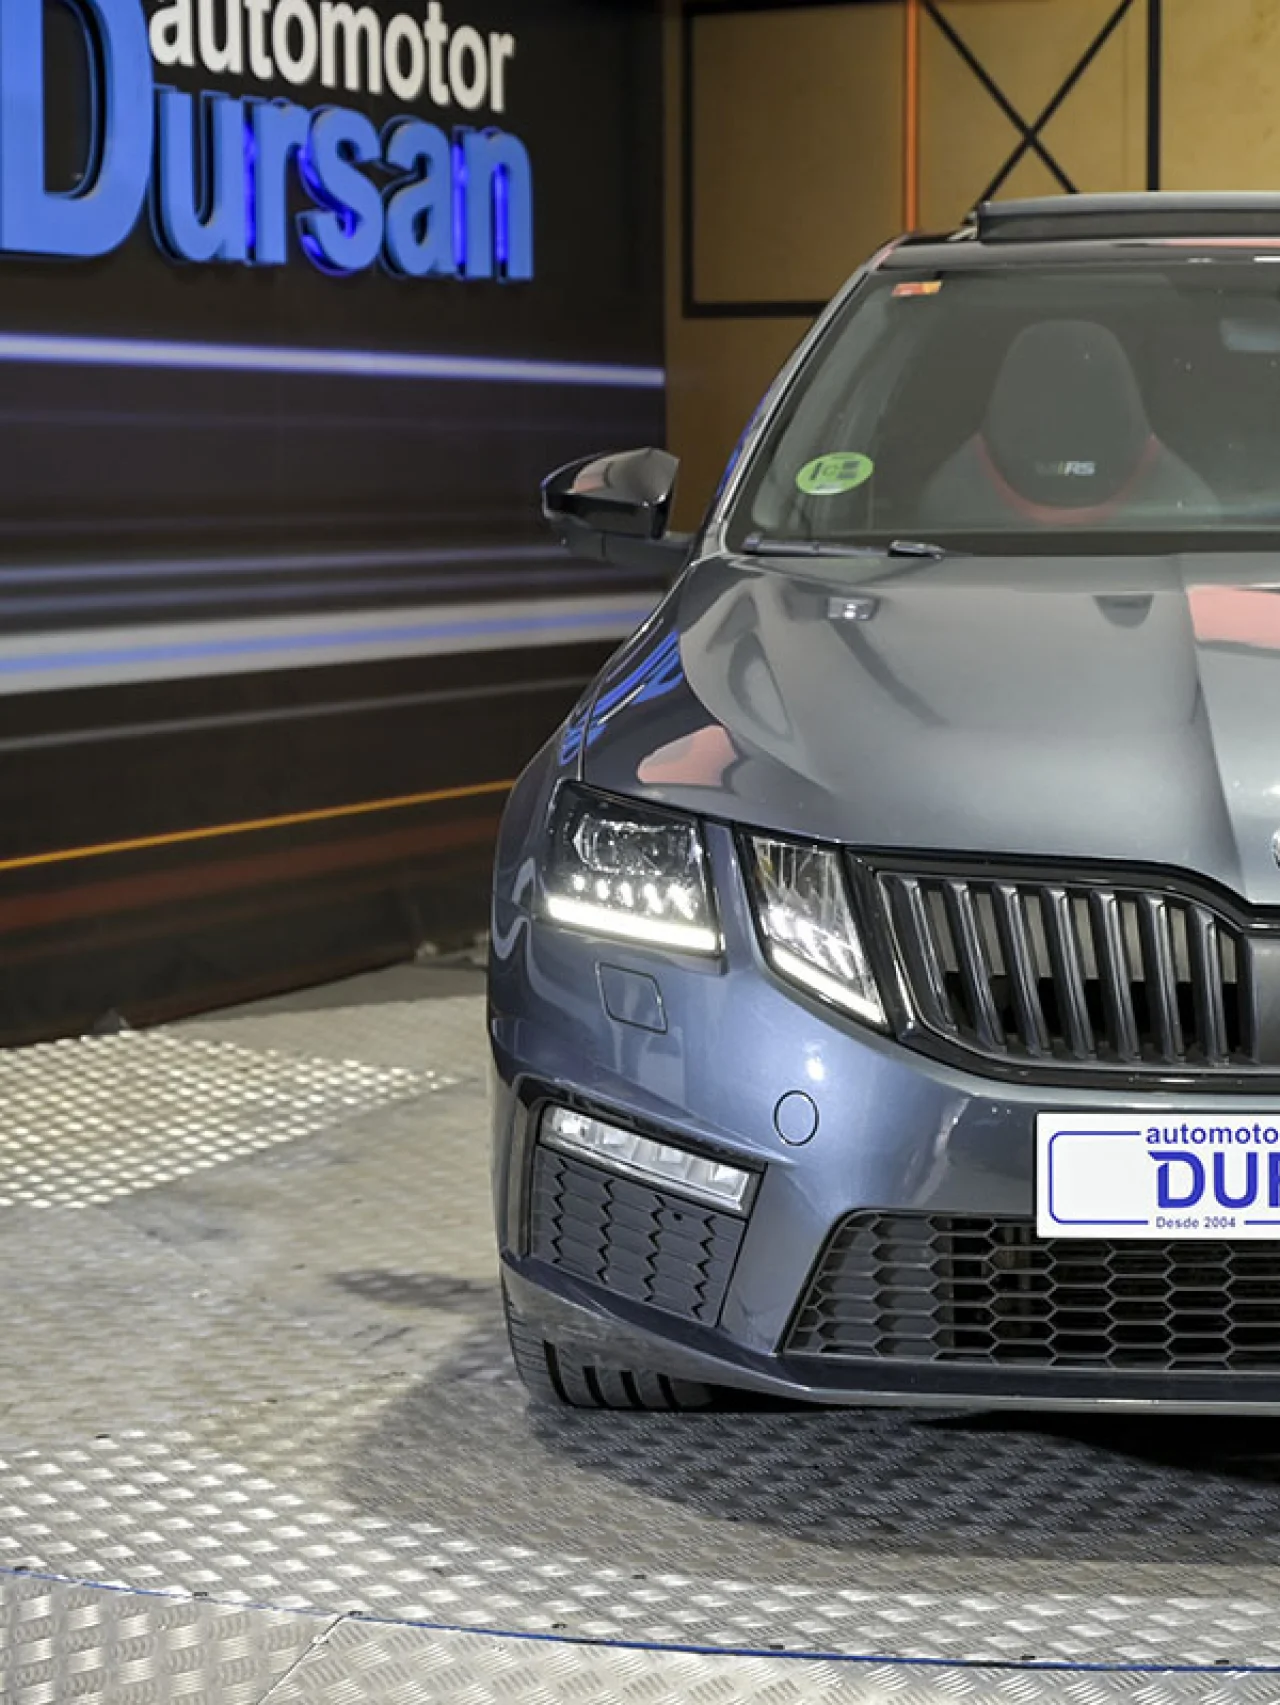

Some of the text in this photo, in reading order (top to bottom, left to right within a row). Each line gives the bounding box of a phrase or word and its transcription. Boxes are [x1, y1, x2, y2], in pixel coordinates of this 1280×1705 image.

[149, 0, 515, 112] automotor
[0, 0, 534, 281] Dursan
[1155, 1215, 1236, 1229] Desde 2004
